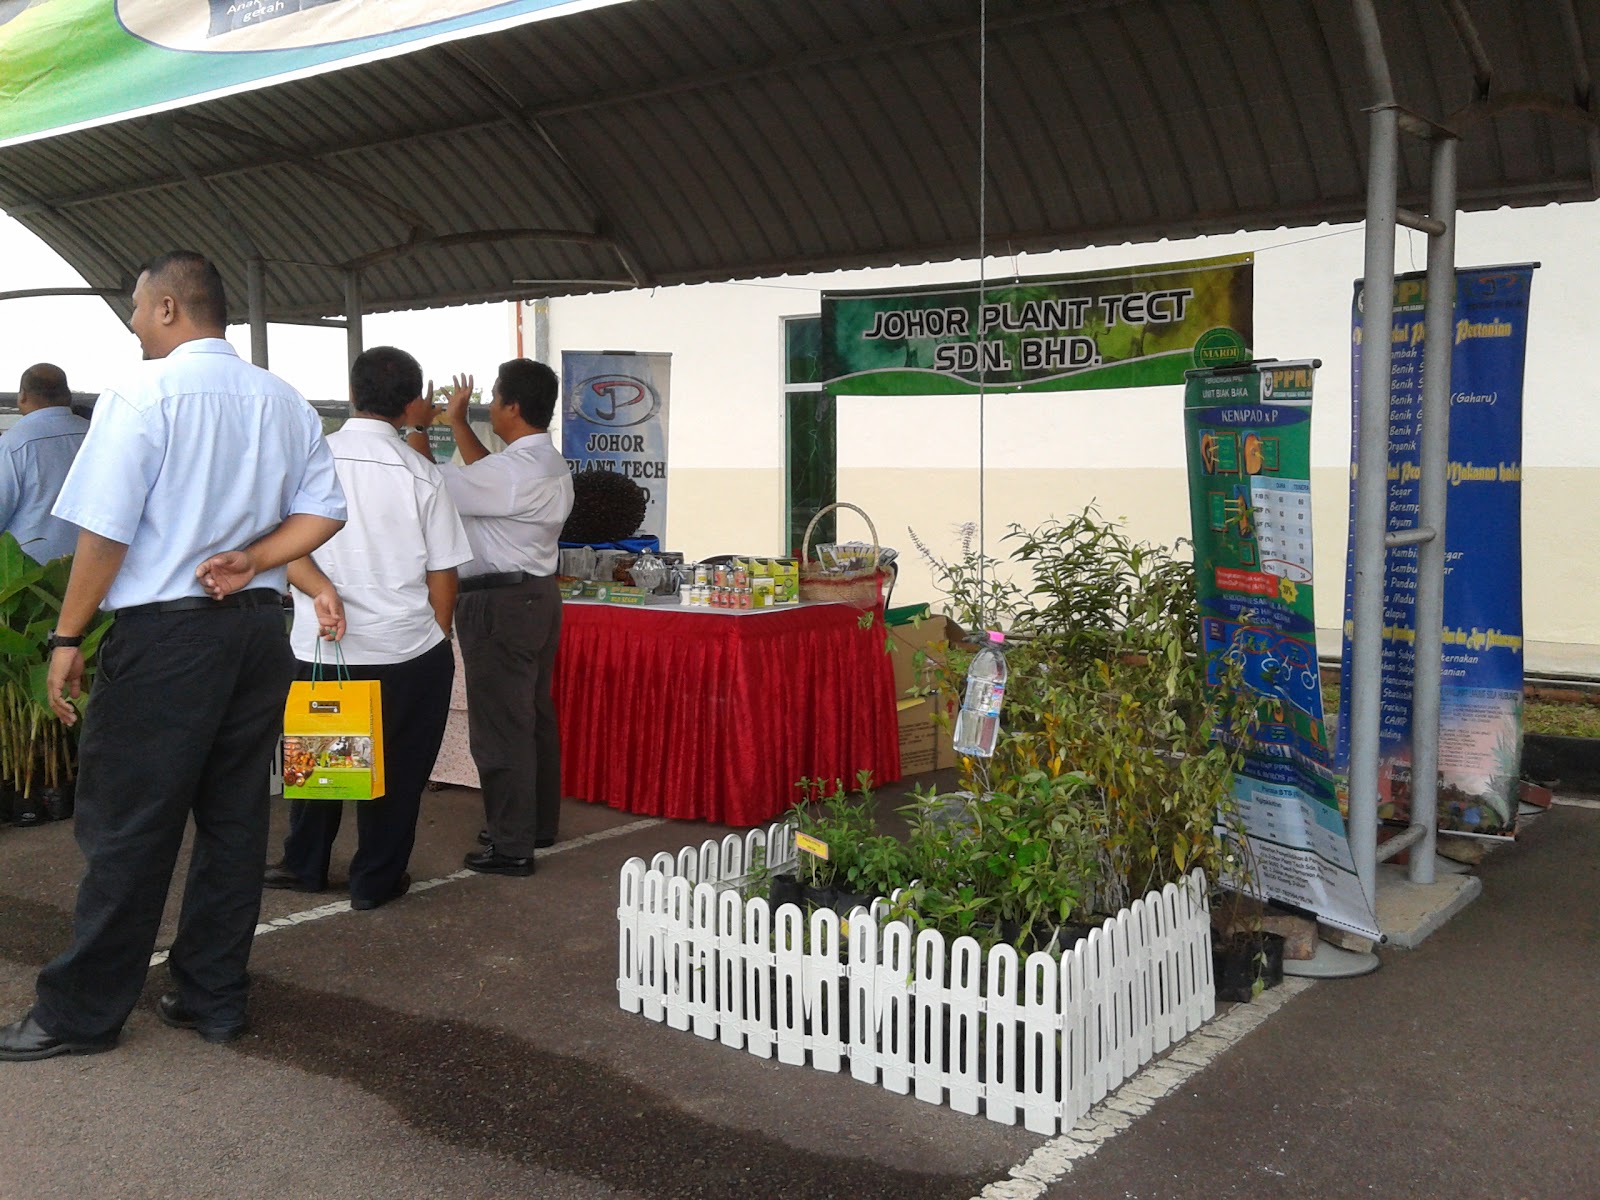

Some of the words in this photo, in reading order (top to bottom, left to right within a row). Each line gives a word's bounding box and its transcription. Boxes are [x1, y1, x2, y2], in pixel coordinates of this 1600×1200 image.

[242, 1, 284, 23] getah
[863, 306, 969, 340] JOHOR
[980, 298, 1088, 335] PLANT
[1102, 288, 1193, 326] TECT
[934, 340, 1012, 373] SDN.
[1020, 335, 1102, 370] BHD.
[1203, 347, 1237, 358] MARDI
[1450, 391, 1497, 406] (Gaharu)
[587, 434, 645, 452] JOHOR
[621, 461, 666, 479] TECH
[1389, 502, 1420, 513] Beremp
